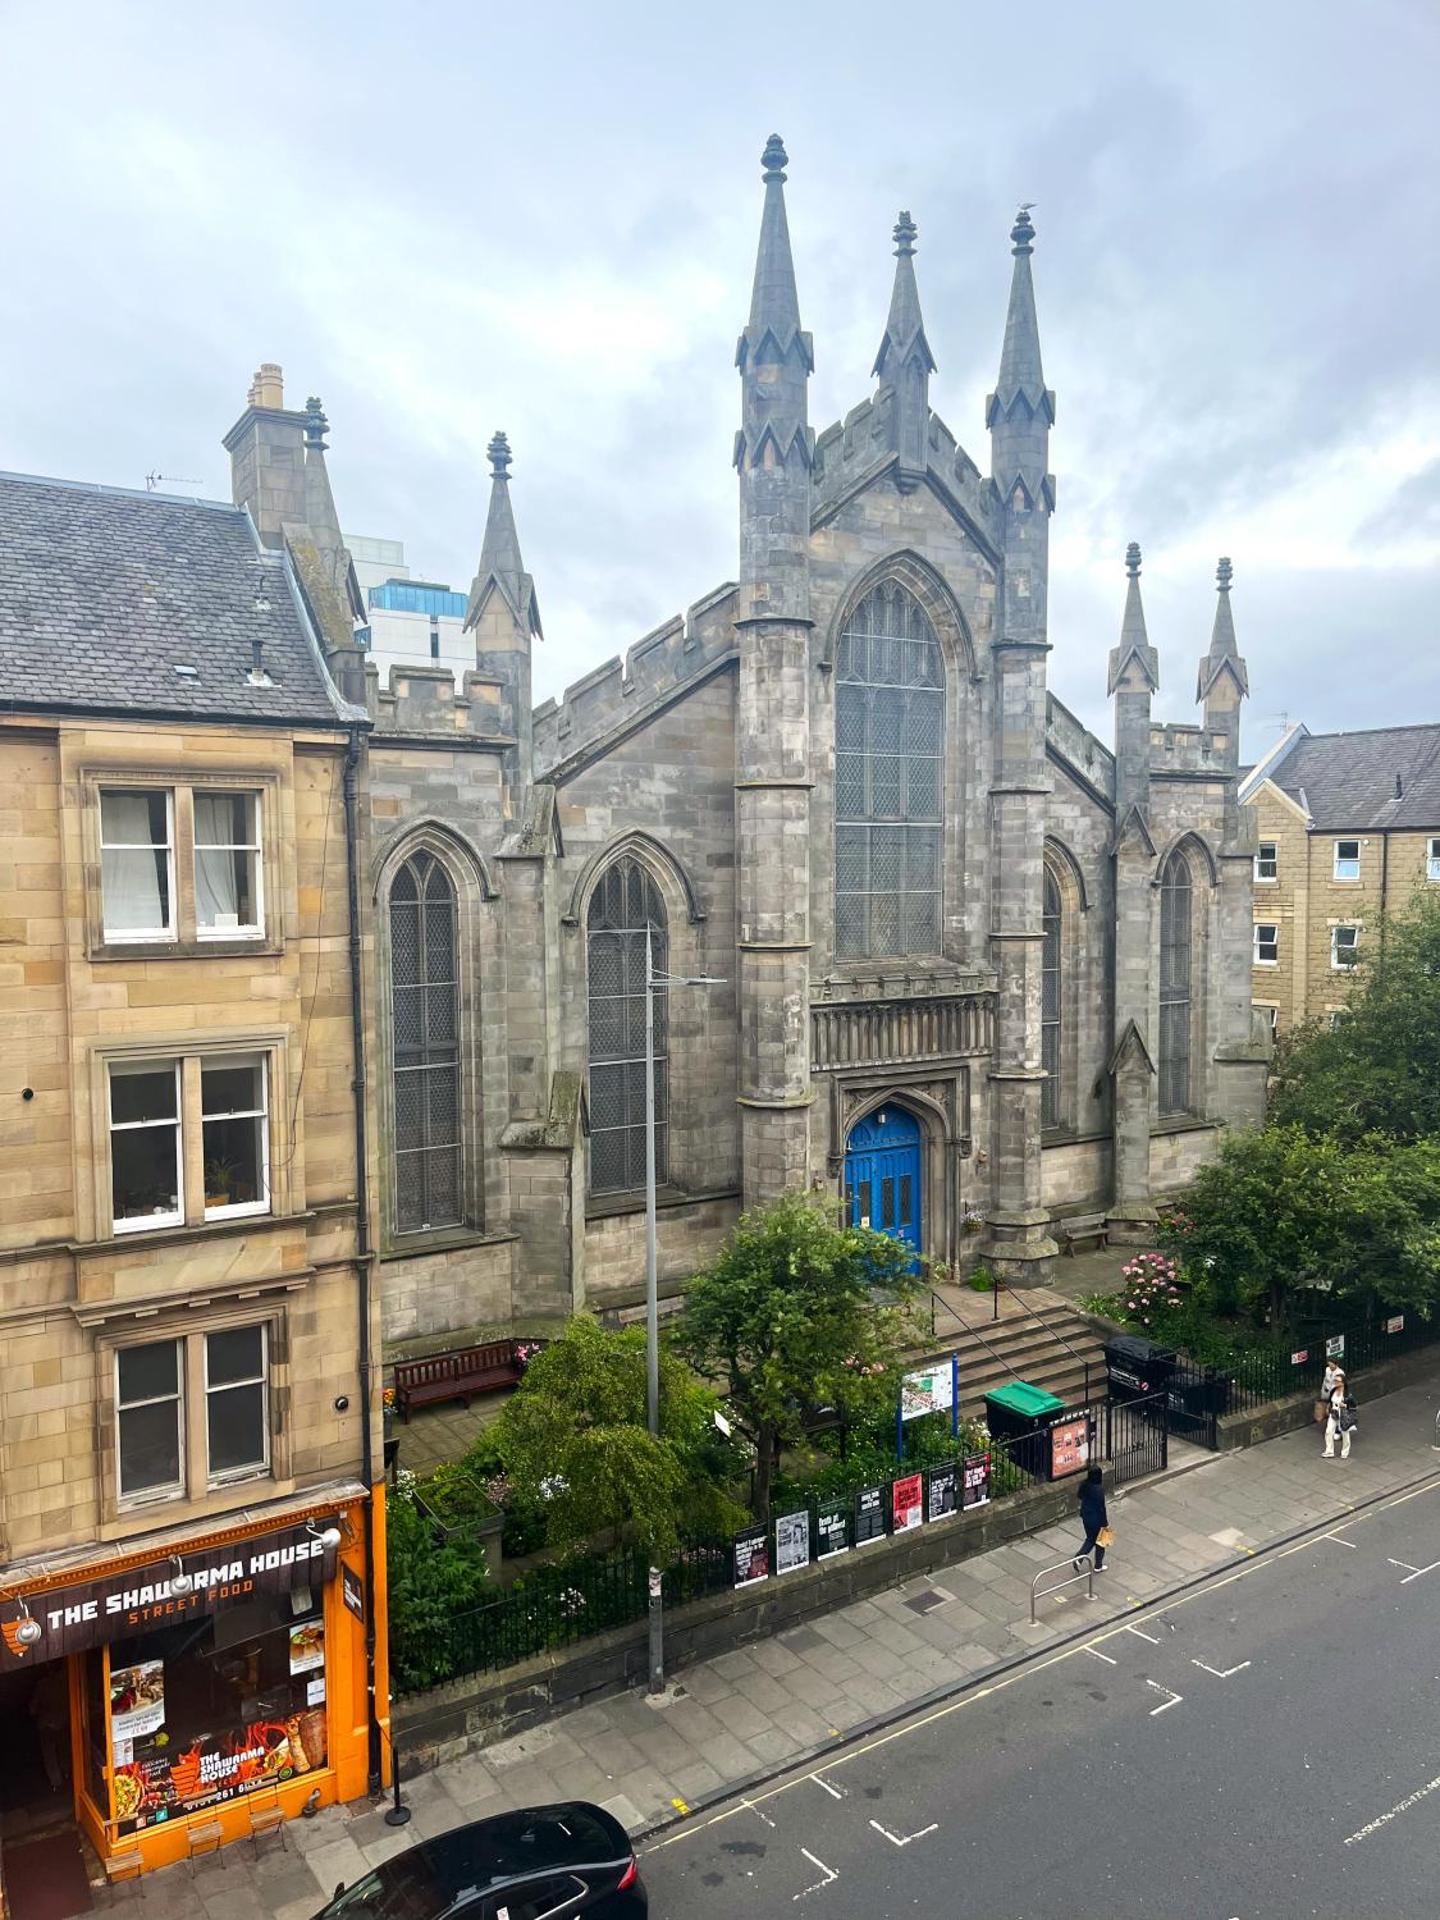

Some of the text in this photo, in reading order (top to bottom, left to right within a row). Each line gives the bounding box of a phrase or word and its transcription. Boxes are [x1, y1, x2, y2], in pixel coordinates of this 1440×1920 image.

[47, 1600, 98, 1629] THE
[250, 1540, 324, 1574] HOUSE
[128, 1580, 253, 1625] STREET FOOD
[200, 1752, 220, 1766] THE
[200, 1746, 265, 1775] SHAWARMA
[201, 1765, 239, 1784] HOUSE
